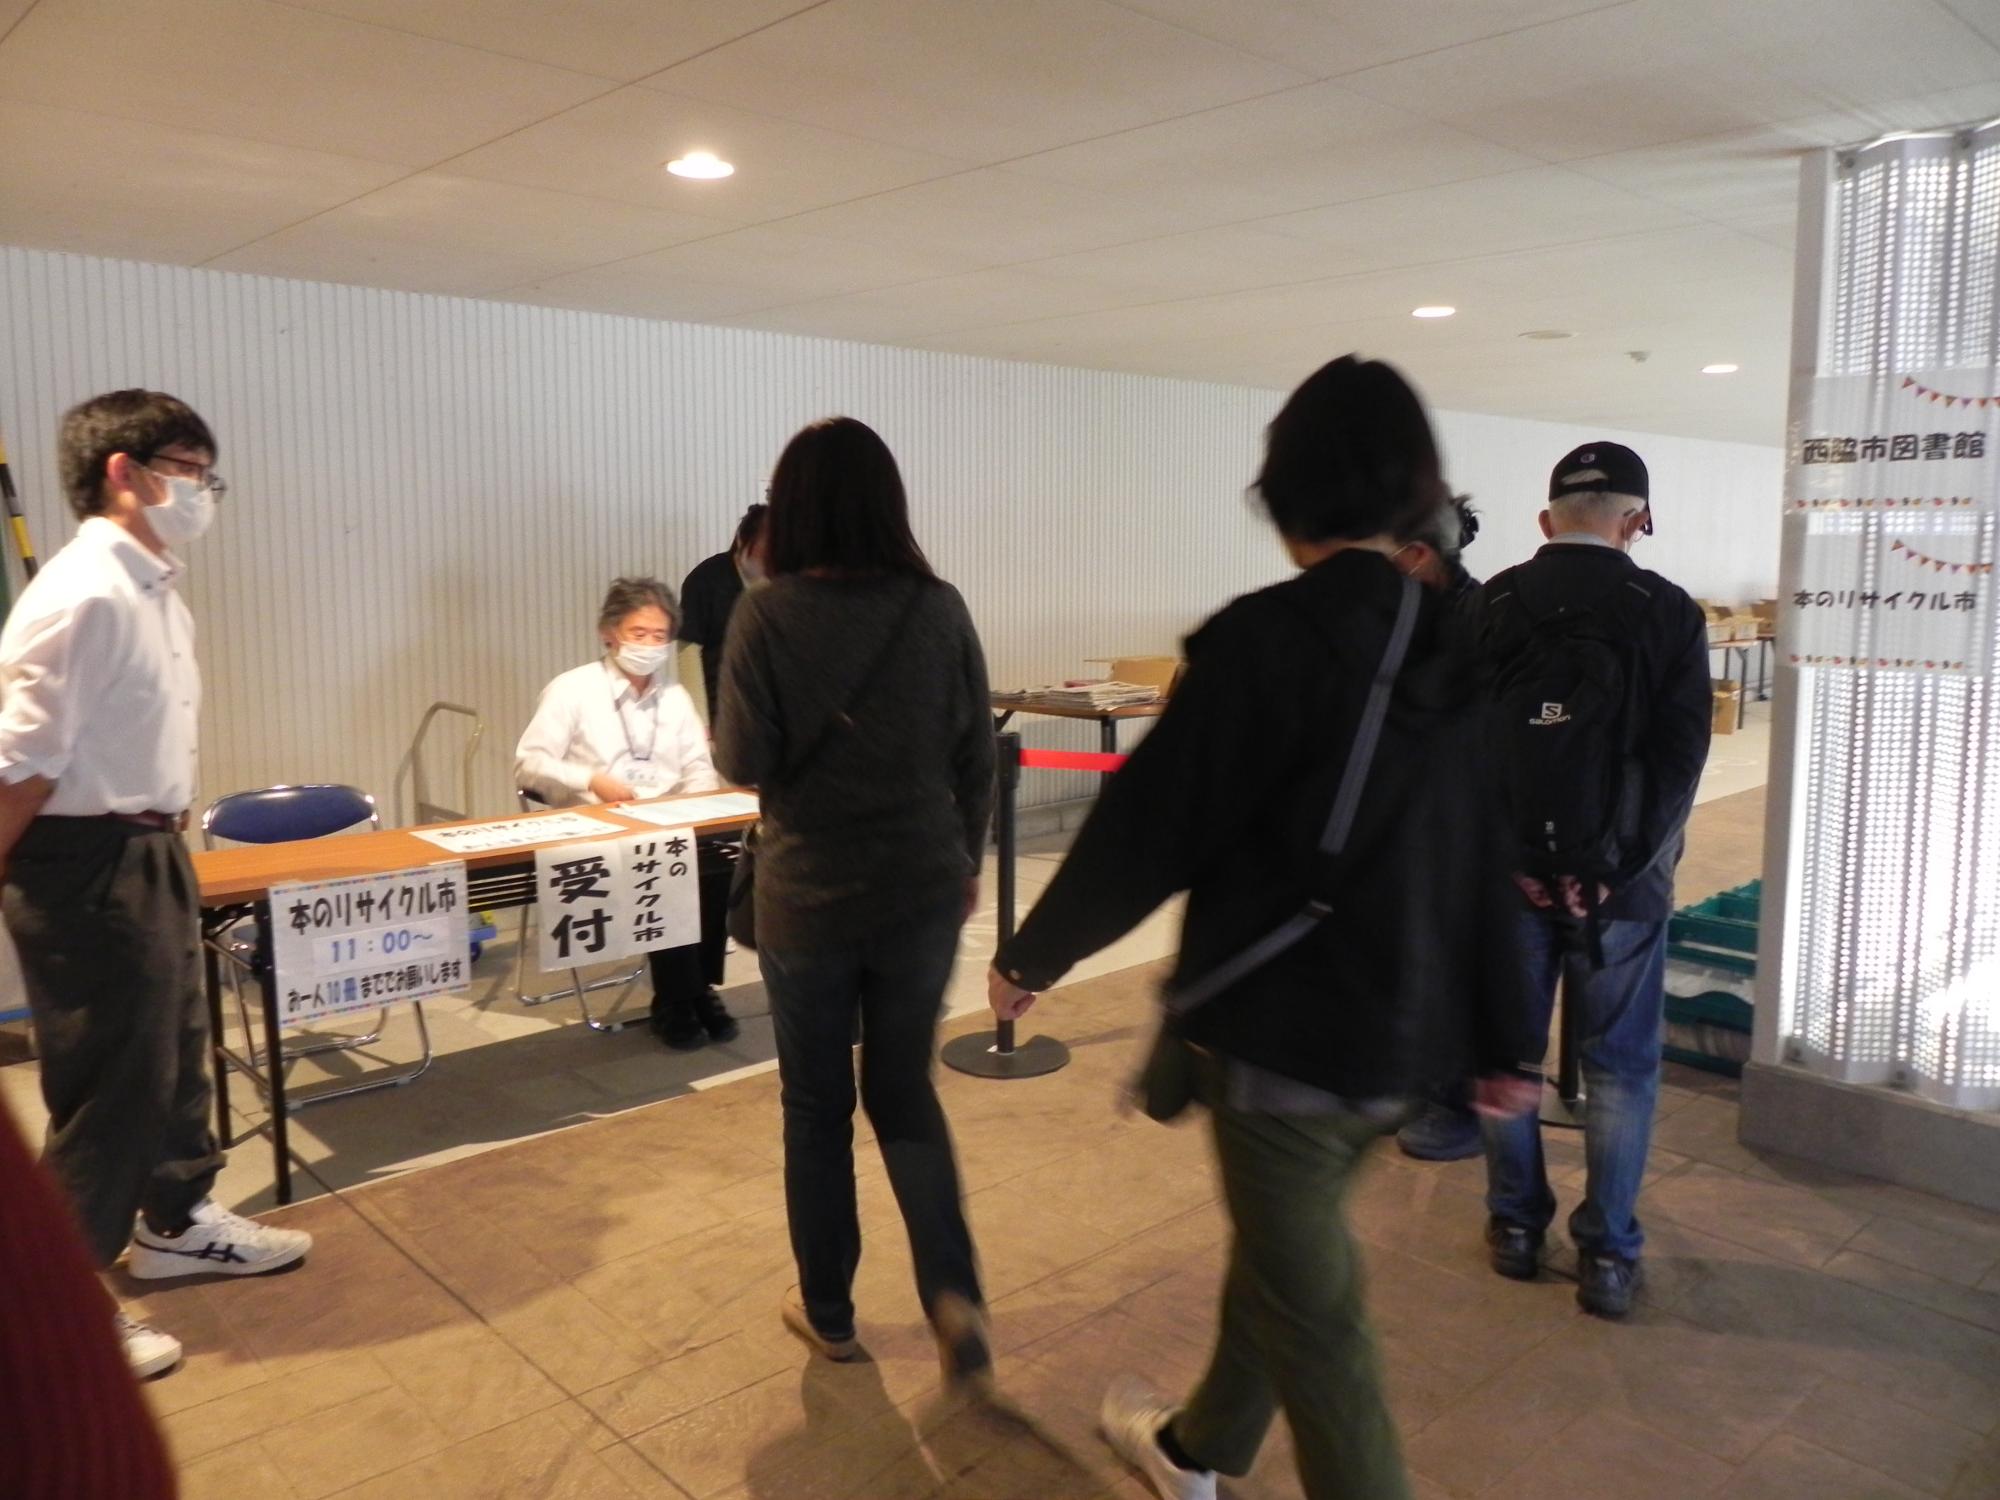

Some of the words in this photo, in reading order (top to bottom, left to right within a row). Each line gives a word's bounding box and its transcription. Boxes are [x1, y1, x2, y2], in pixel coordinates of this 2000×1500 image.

[1803, 431, 1986, 465] 西脇市図書館
[1793, 590, 1976, 612] 本のリサイクル市
[665, 837, 688, 877] 本の
[289, 878, 456, 936] 本のリサイクル市
[550, 856, 613, 958] 受付
[632, 843, 665, 942] リサイクル市
